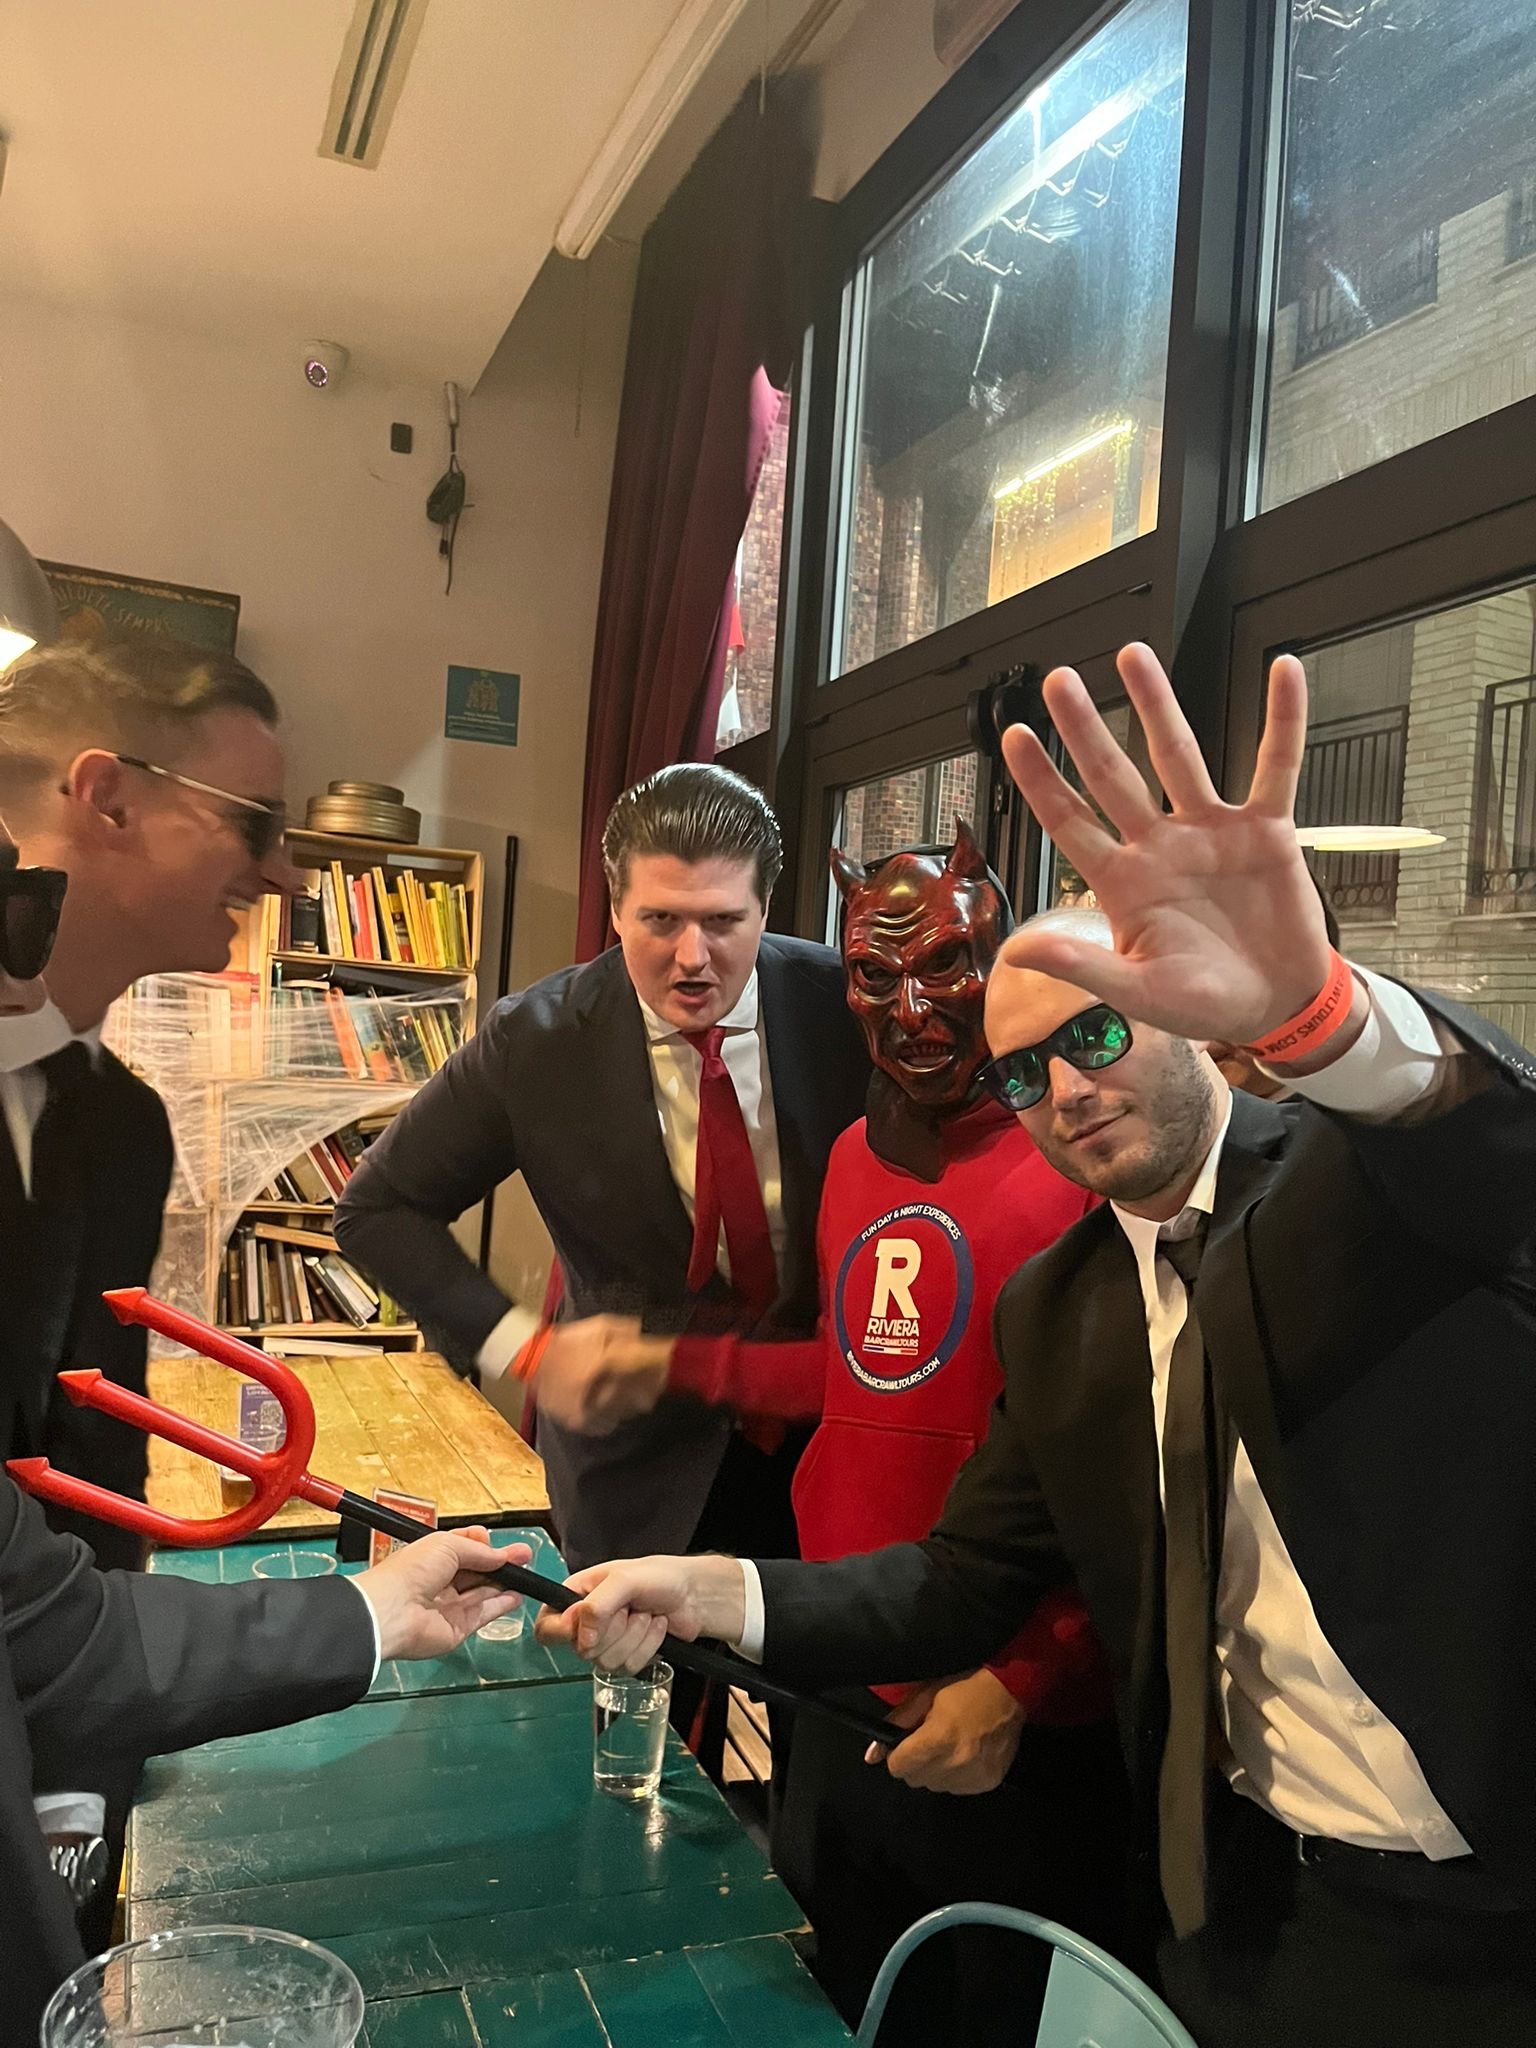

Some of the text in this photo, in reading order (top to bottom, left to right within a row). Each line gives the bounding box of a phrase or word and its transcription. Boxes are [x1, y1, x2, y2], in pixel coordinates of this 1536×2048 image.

[861, 1204, 961, 1241] FUN DAY & NIGHT EXPERIENCES
[870, 1238, 921, 1318] R
[866, 1318, 920, 1337] RIVIERA
